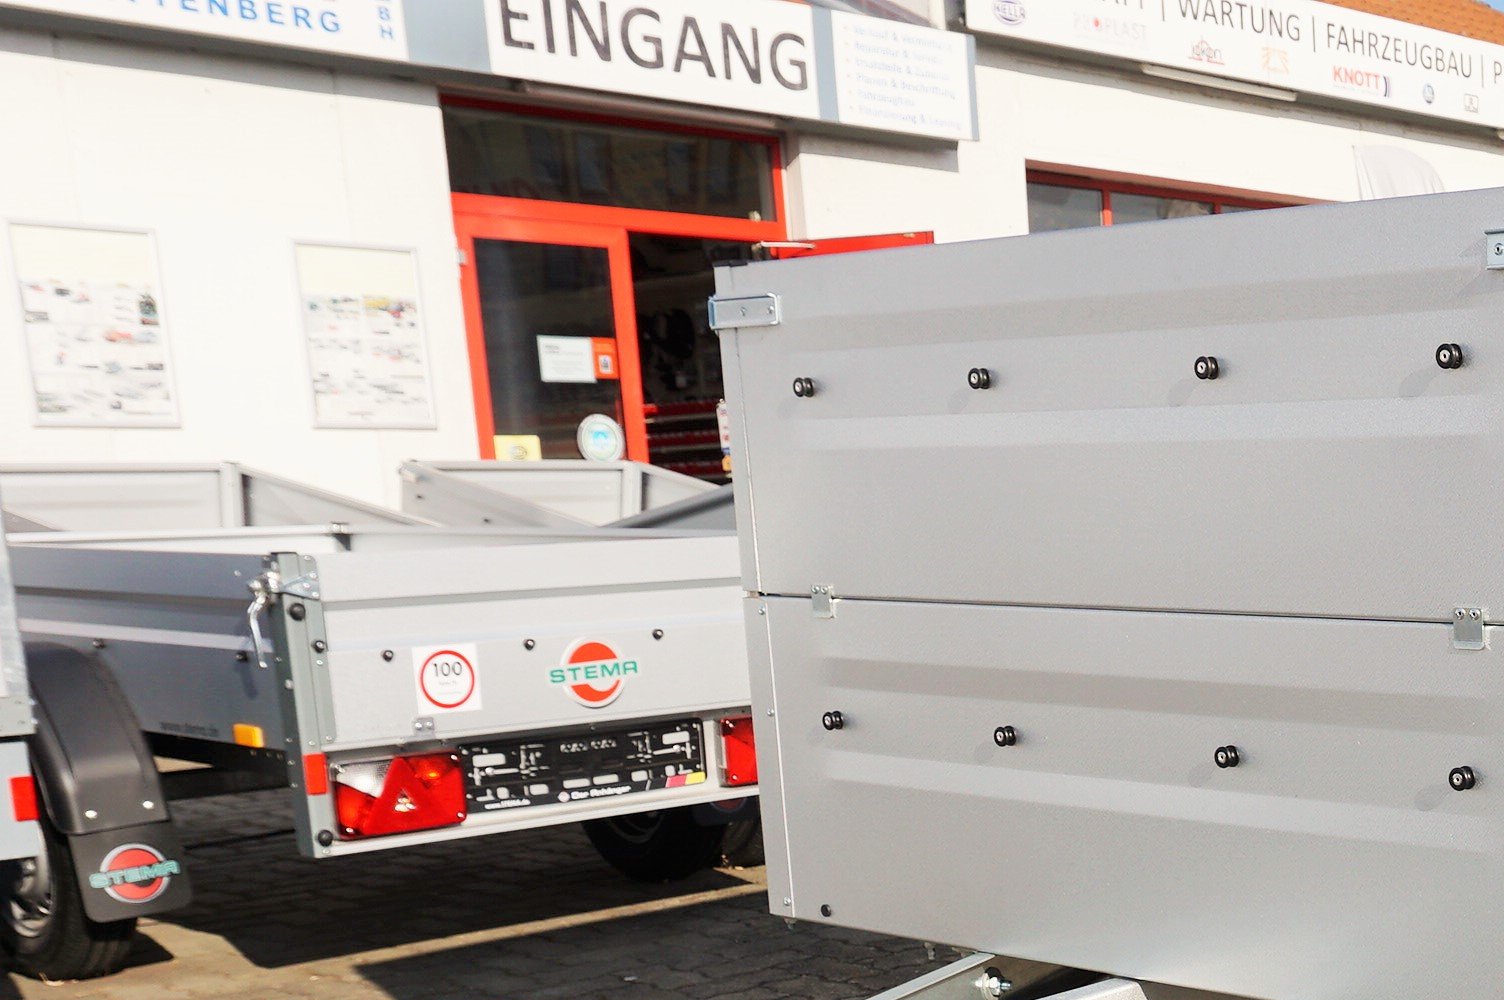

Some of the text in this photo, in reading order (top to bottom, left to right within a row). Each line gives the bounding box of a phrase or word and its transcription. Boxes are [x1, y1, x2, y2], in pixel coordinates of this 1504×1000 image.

[128, 0, 342, 33] ENBERG
[500, 0, 808, 91] EINGANG
[1179, 0, 1300, 42] WARTUNG
[1326, 22, 1473, 79] FAHRZEUGBAU
[1332, 64, 1381, 90] KNOTT
[432, 661, 463, 677] 100
[550, 659, 639, 684] STEMA
[88, 860, 182, 889] STEMA
